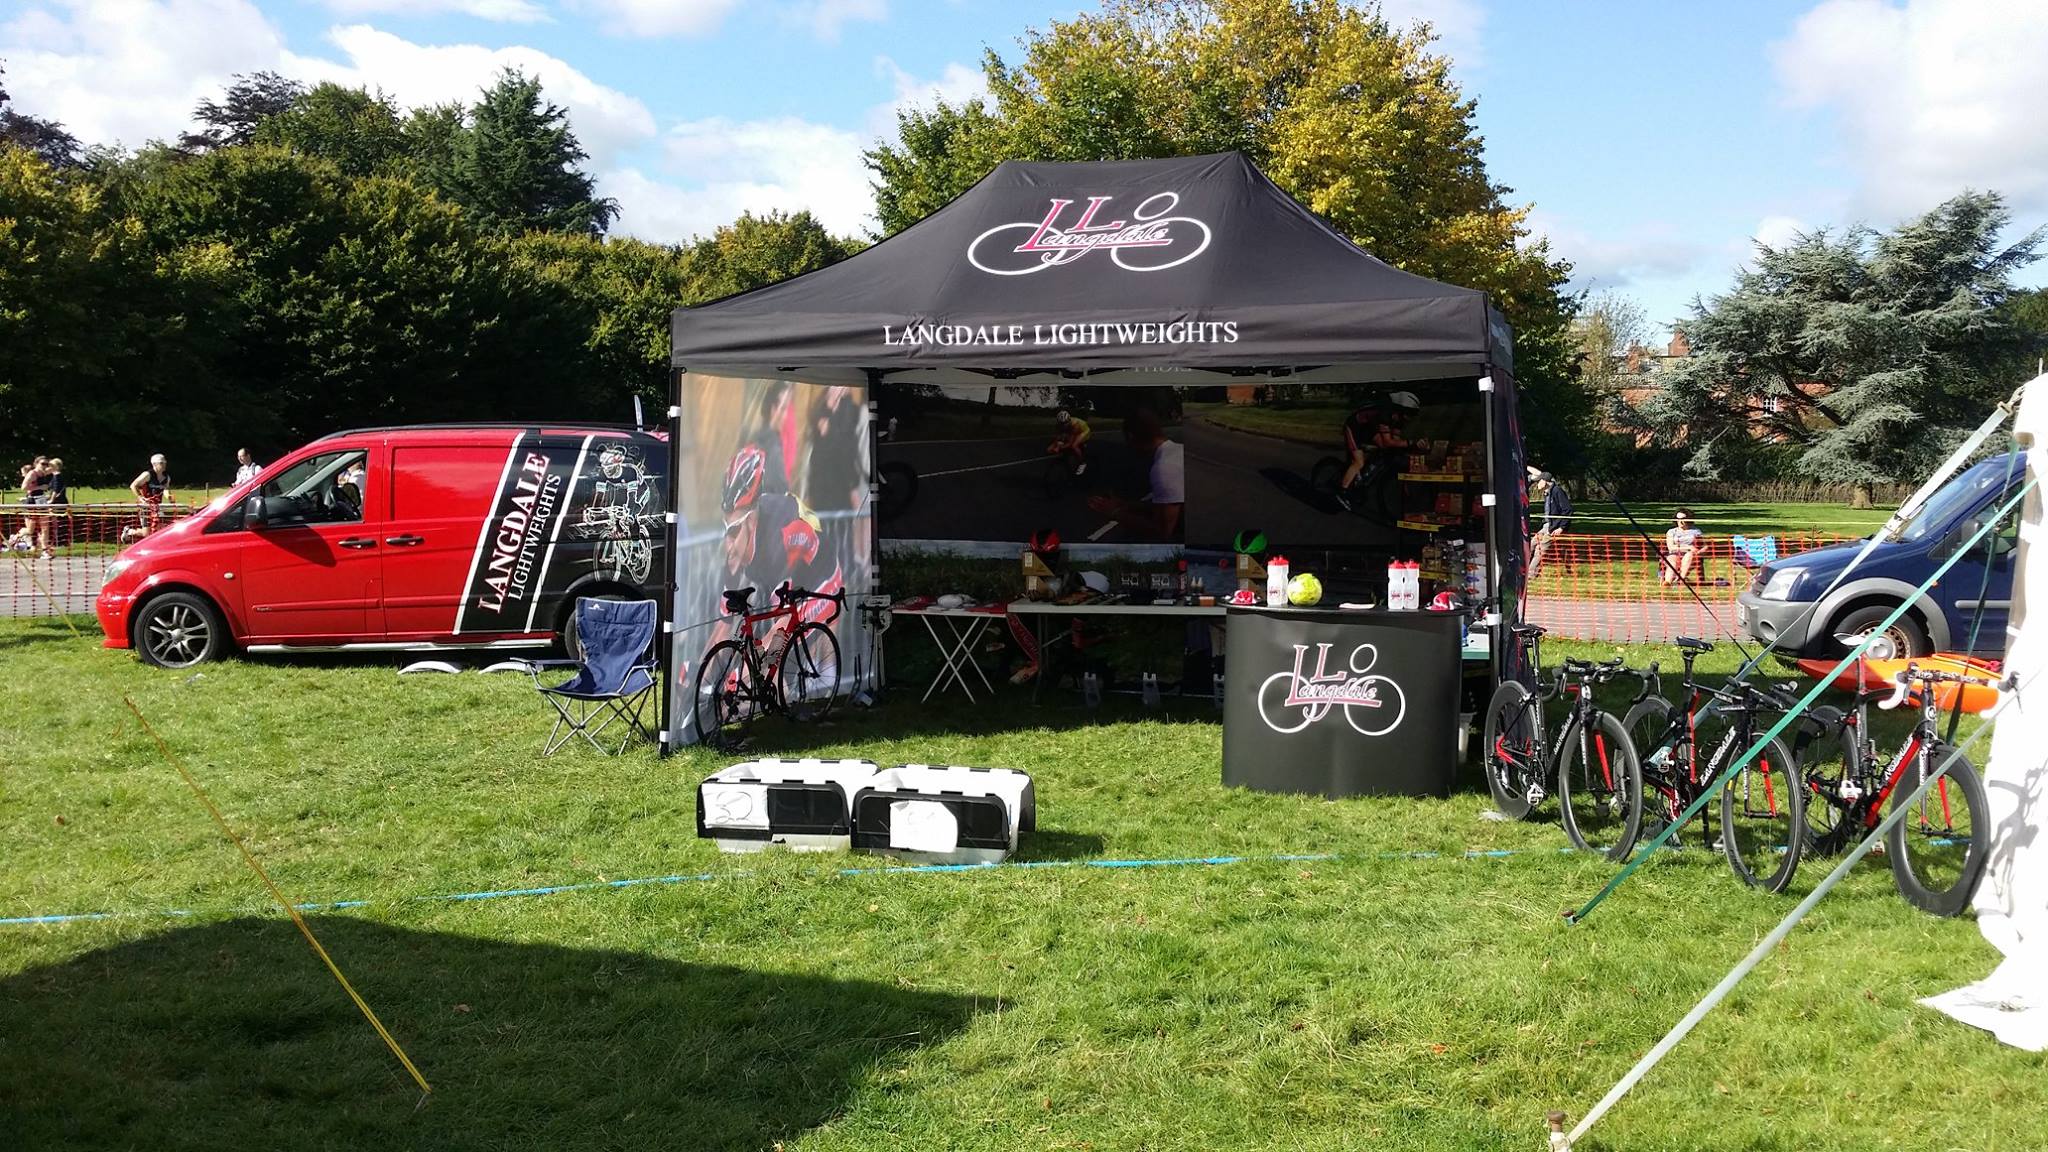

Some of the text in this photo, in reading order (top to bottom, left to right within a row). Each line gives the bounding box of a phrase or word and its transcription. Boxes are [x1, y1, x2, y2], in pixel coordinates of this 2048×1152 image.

[882, 320, 1240, 347] LANGDALE LIGHTWEIGHTS
[477, 452, 550, 614] LANGDALE
[507, 473, 562, 601] LIGHTWEIGHTS
